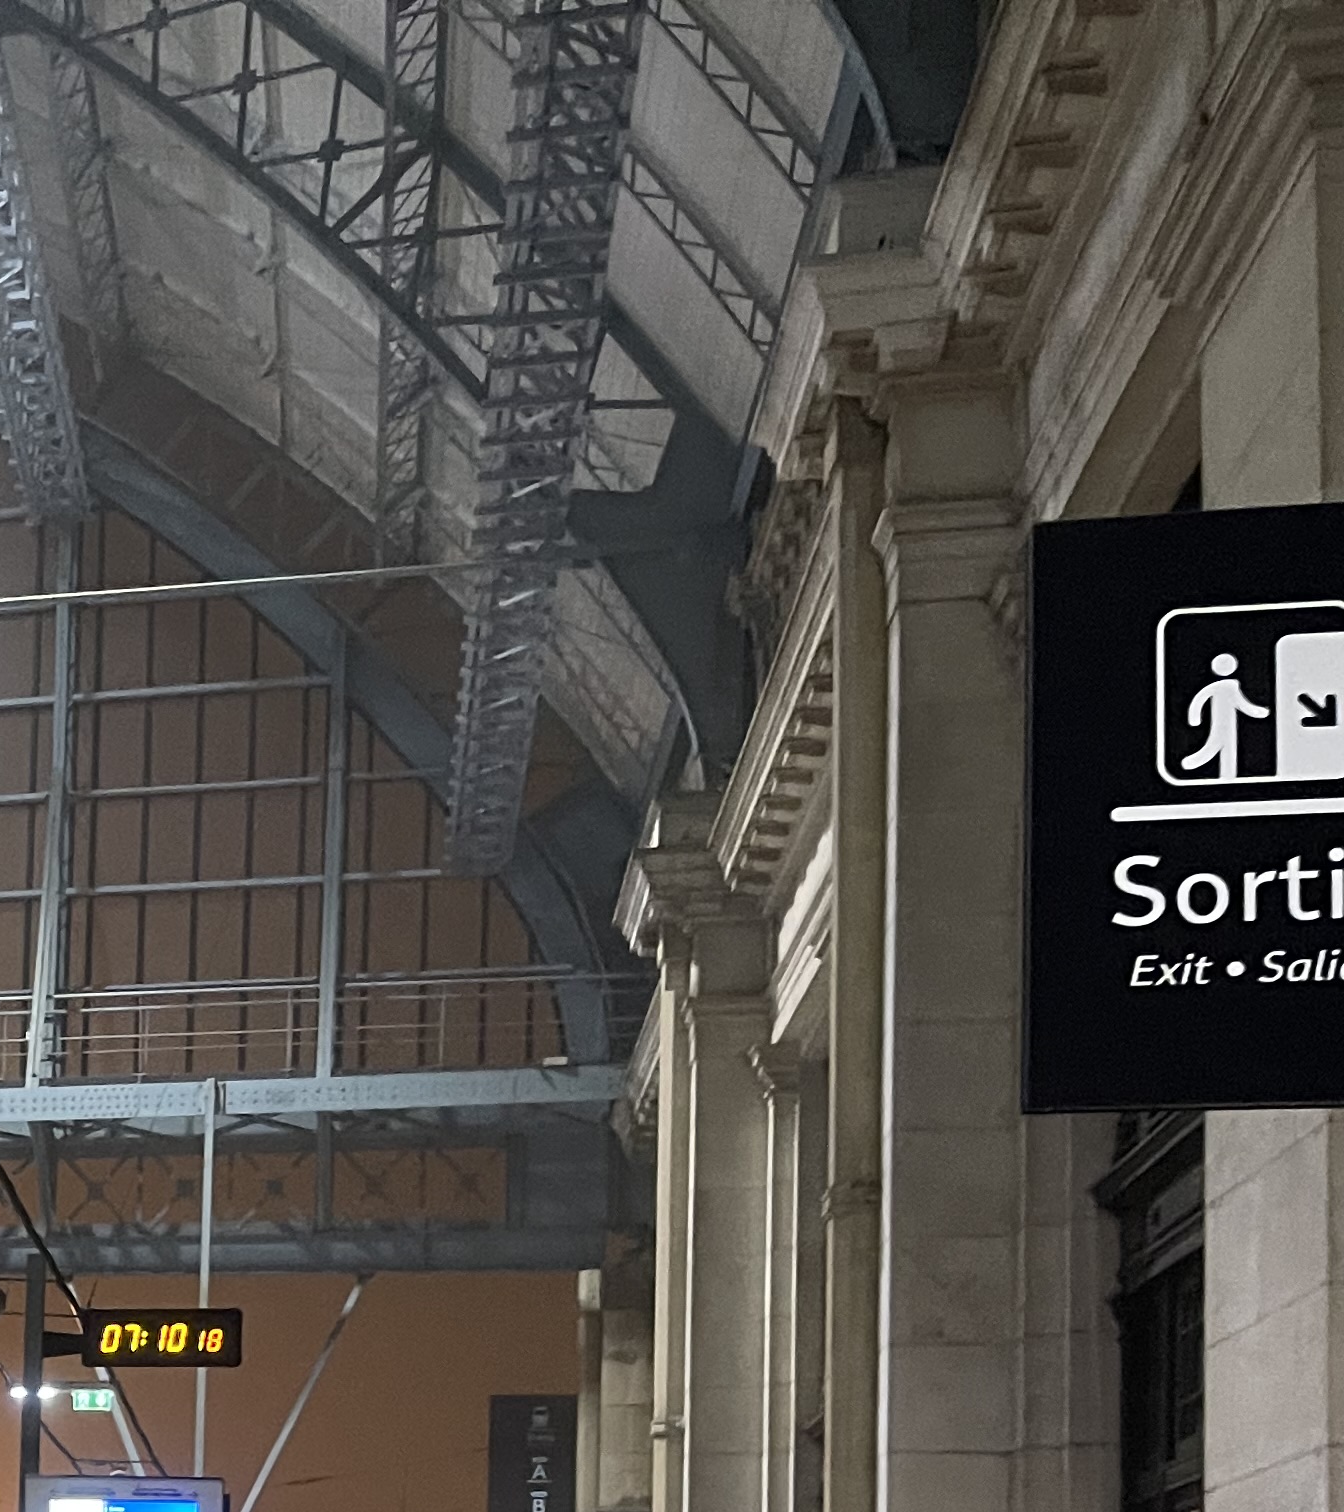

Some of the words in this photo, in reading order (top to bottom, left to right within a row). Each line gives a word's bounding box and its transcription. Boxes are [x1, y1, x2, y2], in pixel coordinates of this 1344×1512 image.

[1112, 847, 1344, 927] Sorti
[1130, 953, 1213, 987] Exit
[1257, 949, 1344, 982] Sali
[100, 1323, 188, 1353] 07:10
[197, 1328, 224, 1353] 18
[531, 1464, 547, 1480] A
